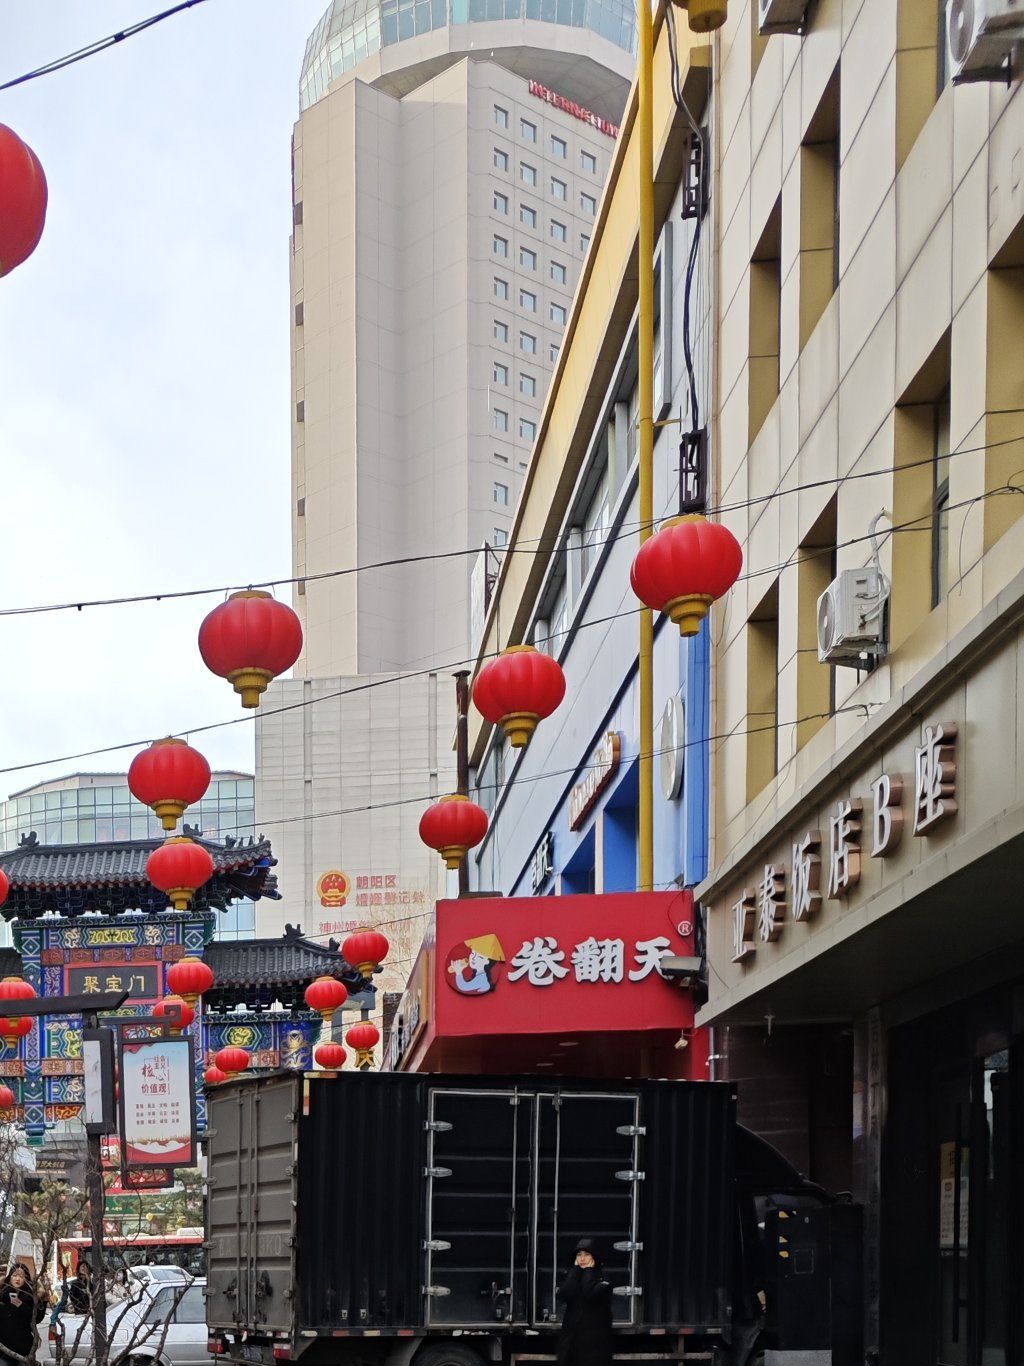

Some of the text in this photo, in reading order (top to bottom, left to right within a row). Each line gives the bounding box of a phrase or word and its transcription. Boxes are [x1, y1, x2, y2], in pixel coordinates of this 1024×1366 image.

[732, 722, 959, 963] 亚泰饭店B座
[356, 875, 397, 888] 朝阳区
[507, 935, 678, 987] 卷翻天
[81, 974, 145, 994] 聚宝门
[141, 1083, 167, 1094] 价值观
